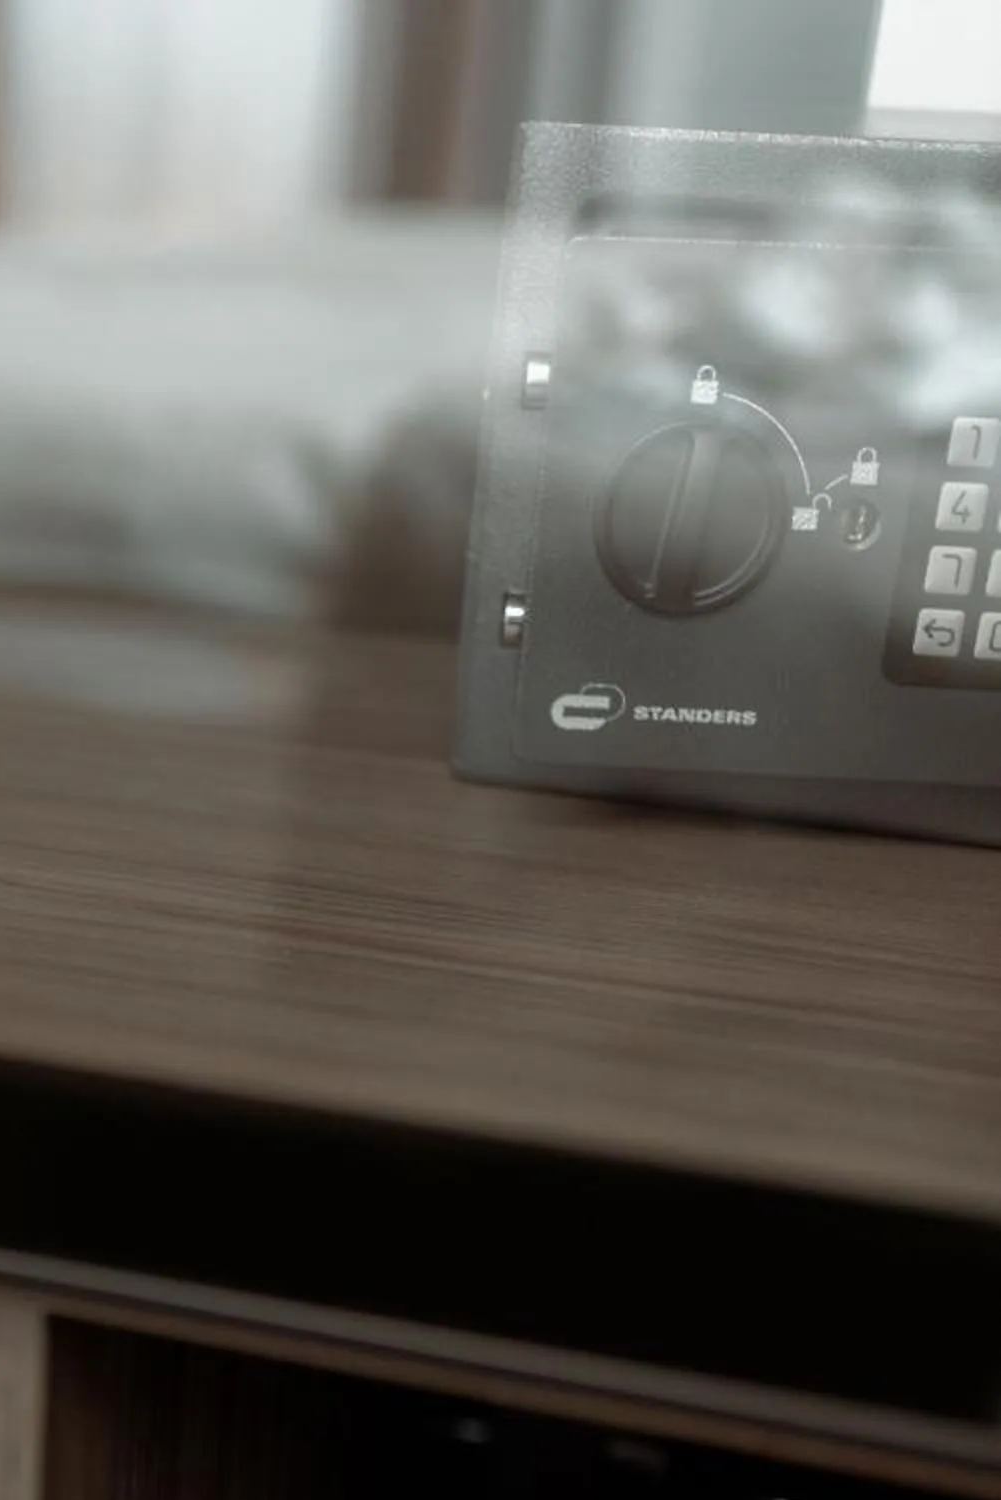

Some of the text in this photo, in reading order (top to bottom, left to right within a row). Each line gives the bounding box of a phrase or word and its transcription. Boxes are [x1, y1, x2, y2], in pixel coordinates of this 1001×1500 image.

[971, 424, 983, 460] 1
[950, 490, 971, 525] 4
[941, 552, 963, 588] 7
[633, 705, 758, 726] STANDERS
